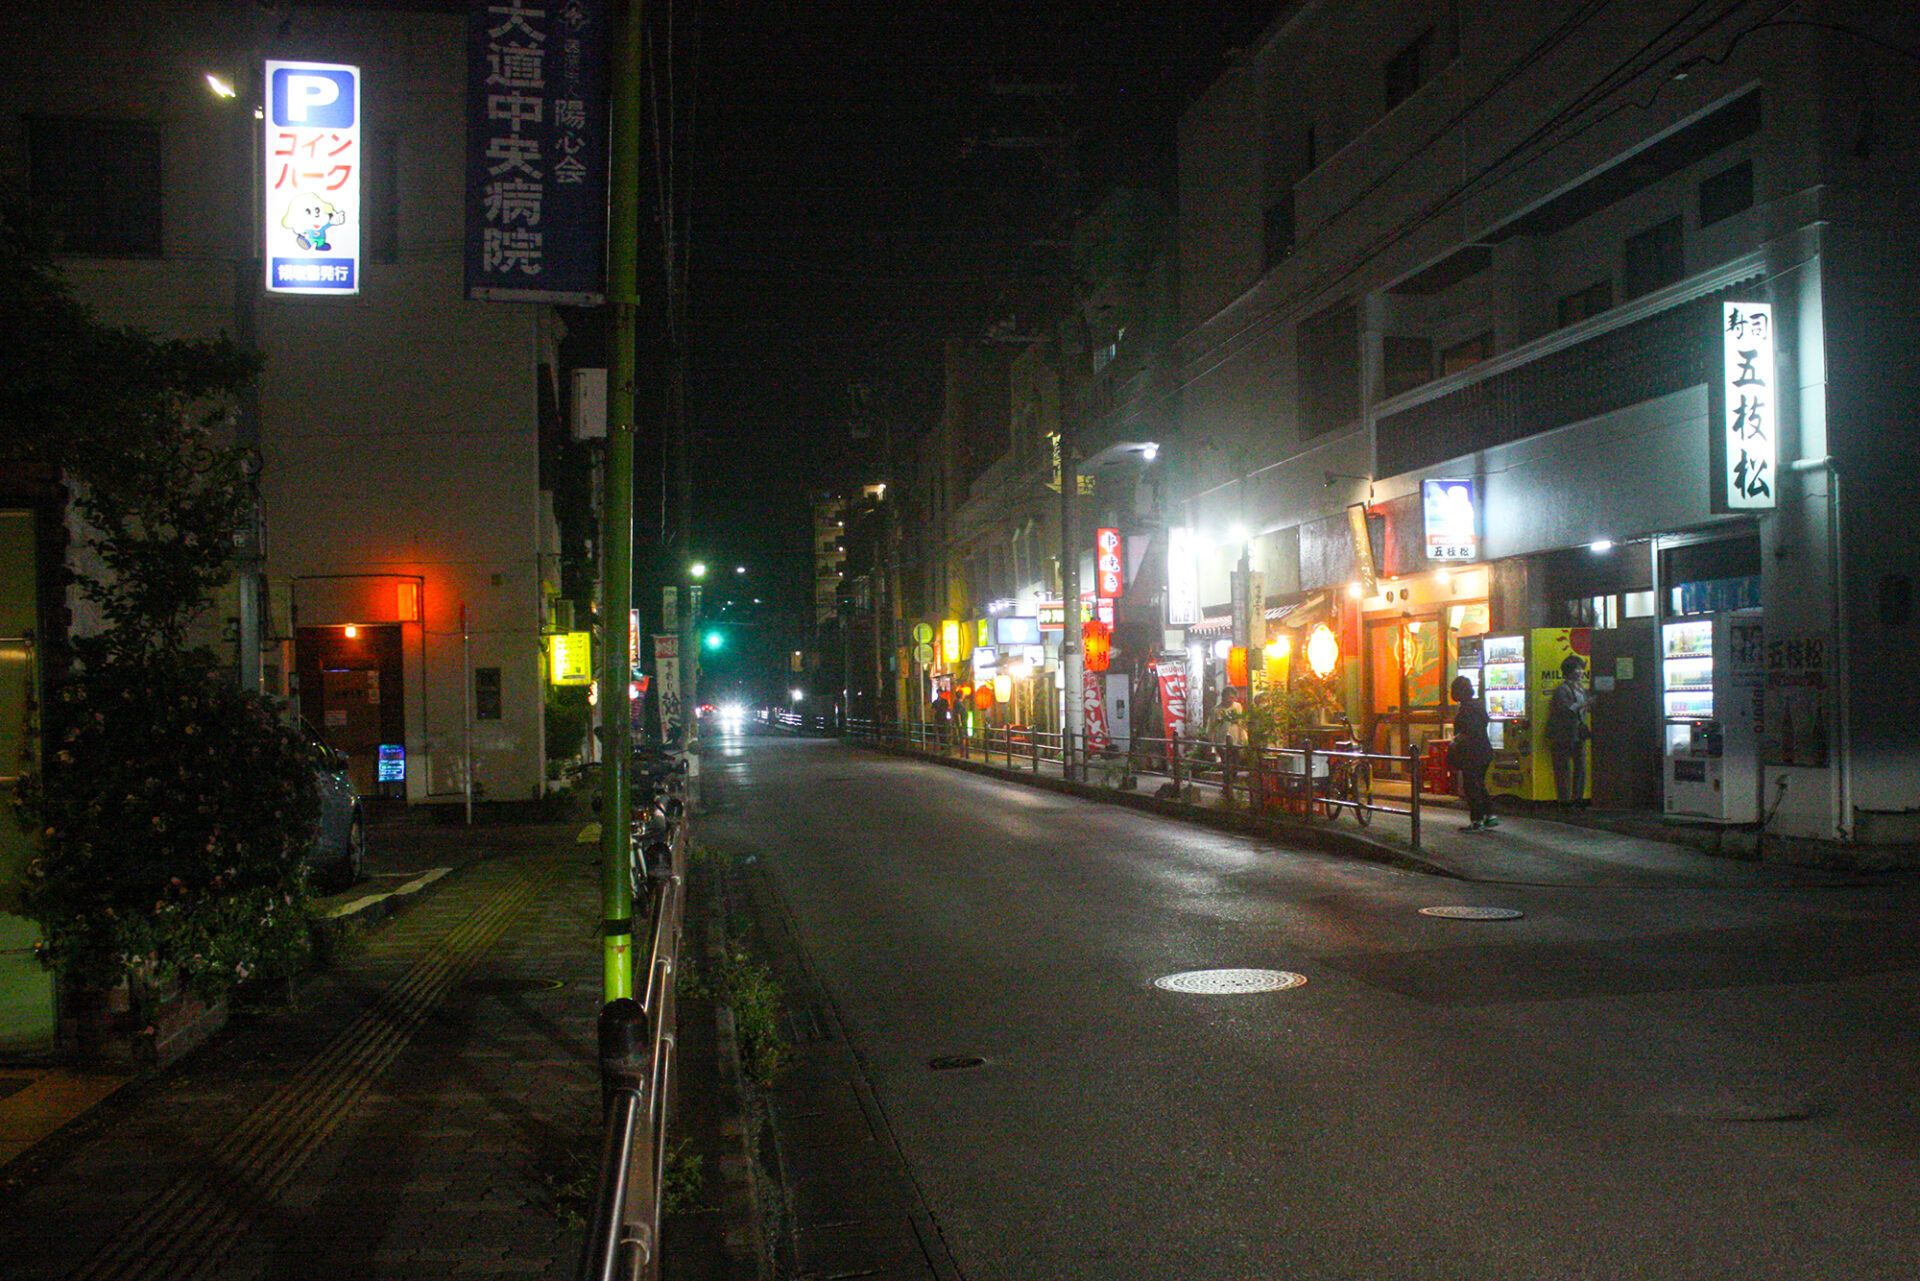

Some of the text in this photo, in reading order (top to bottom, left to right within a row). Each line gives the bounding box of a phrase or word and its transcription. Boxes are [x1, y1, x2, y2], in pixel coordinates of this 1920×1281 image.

[287, 75, 340, 122] P
[274, 132, 353, 158] コイン
[483, 0, 546, 275] 大道中央病院
[554, 100, 587, 184] 陽心会
[1725, 307, 1769, 340] 寿司
[1731, 349, 1771, 500] 五枝松
